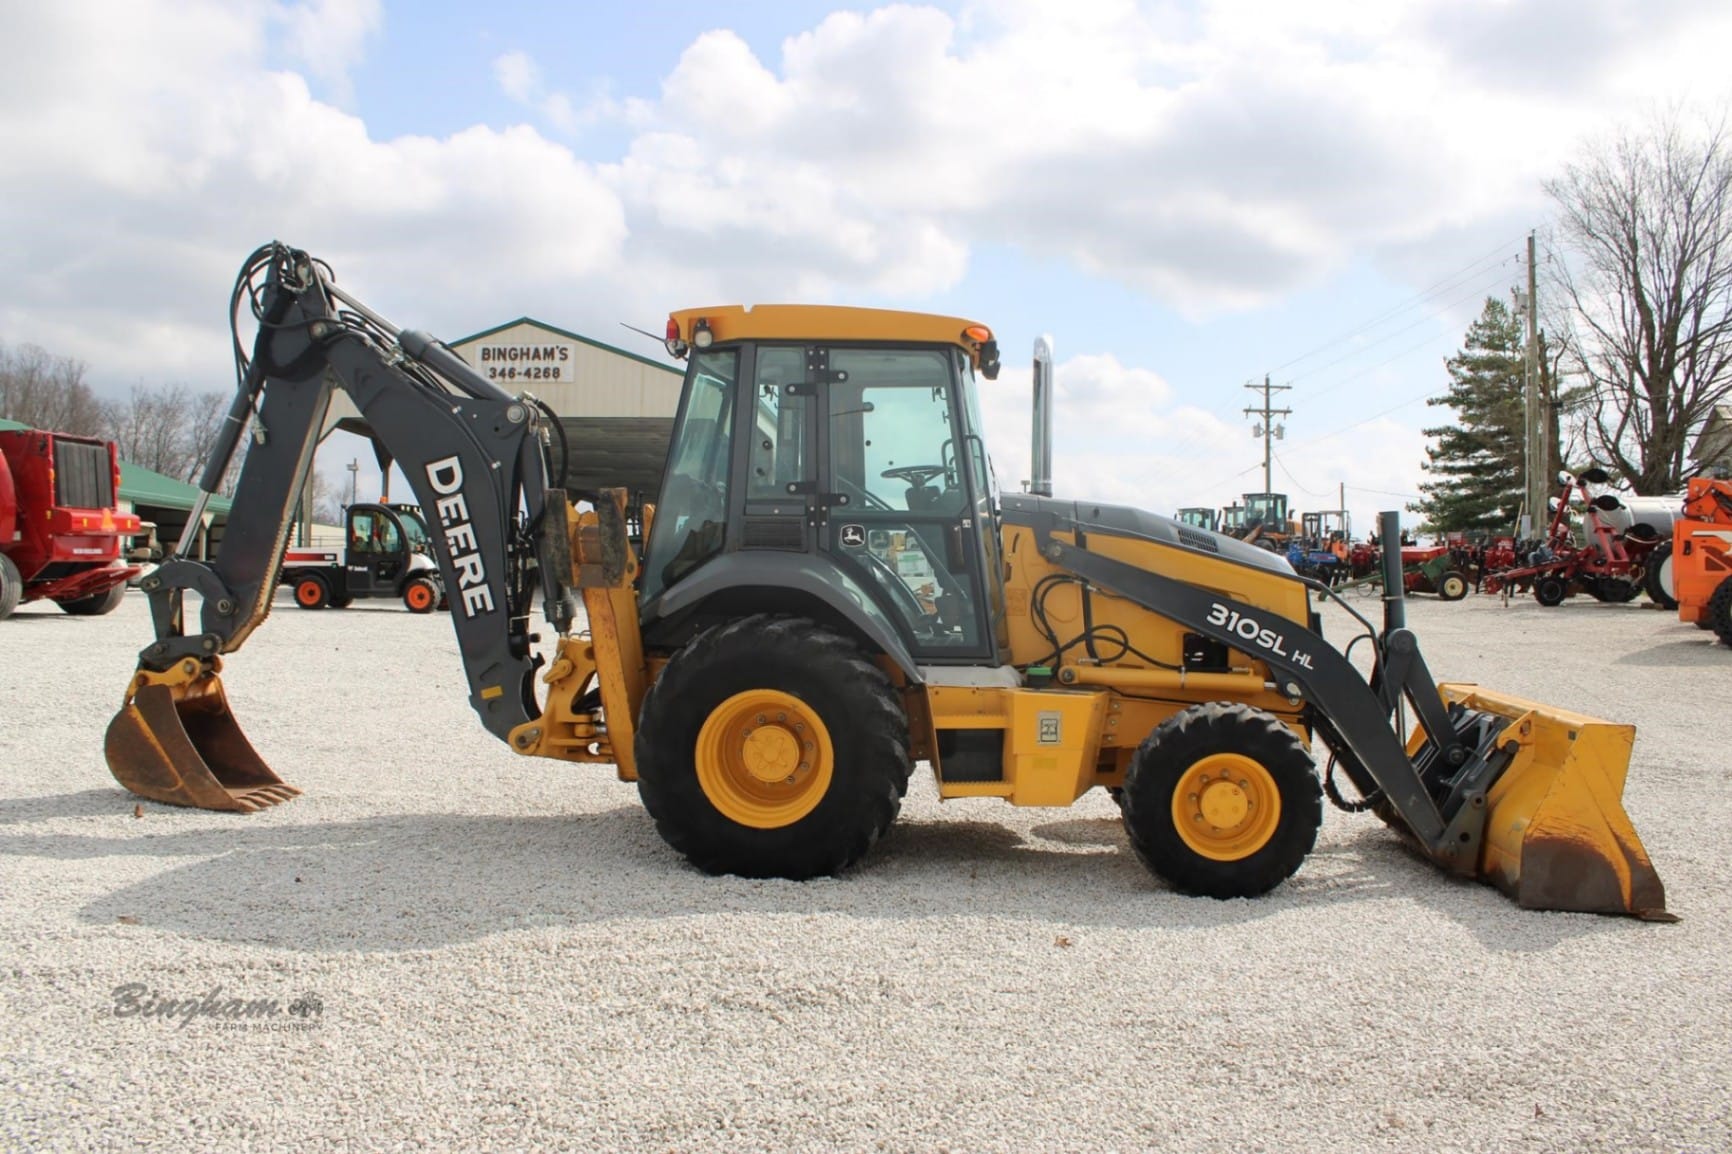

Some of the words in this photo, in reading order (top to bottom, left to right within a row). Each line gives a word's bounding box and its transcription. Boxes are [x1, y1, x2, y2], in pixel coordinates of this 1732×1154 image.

[481, 345, 569, 361] BINGHAM'S
[489, 367, 561, 380] 346-4268
[425, 455, 495, 618] DEERE
[1206, 602, 1287, 657] 310SL
[1291, 649, 1315, 671] HL
